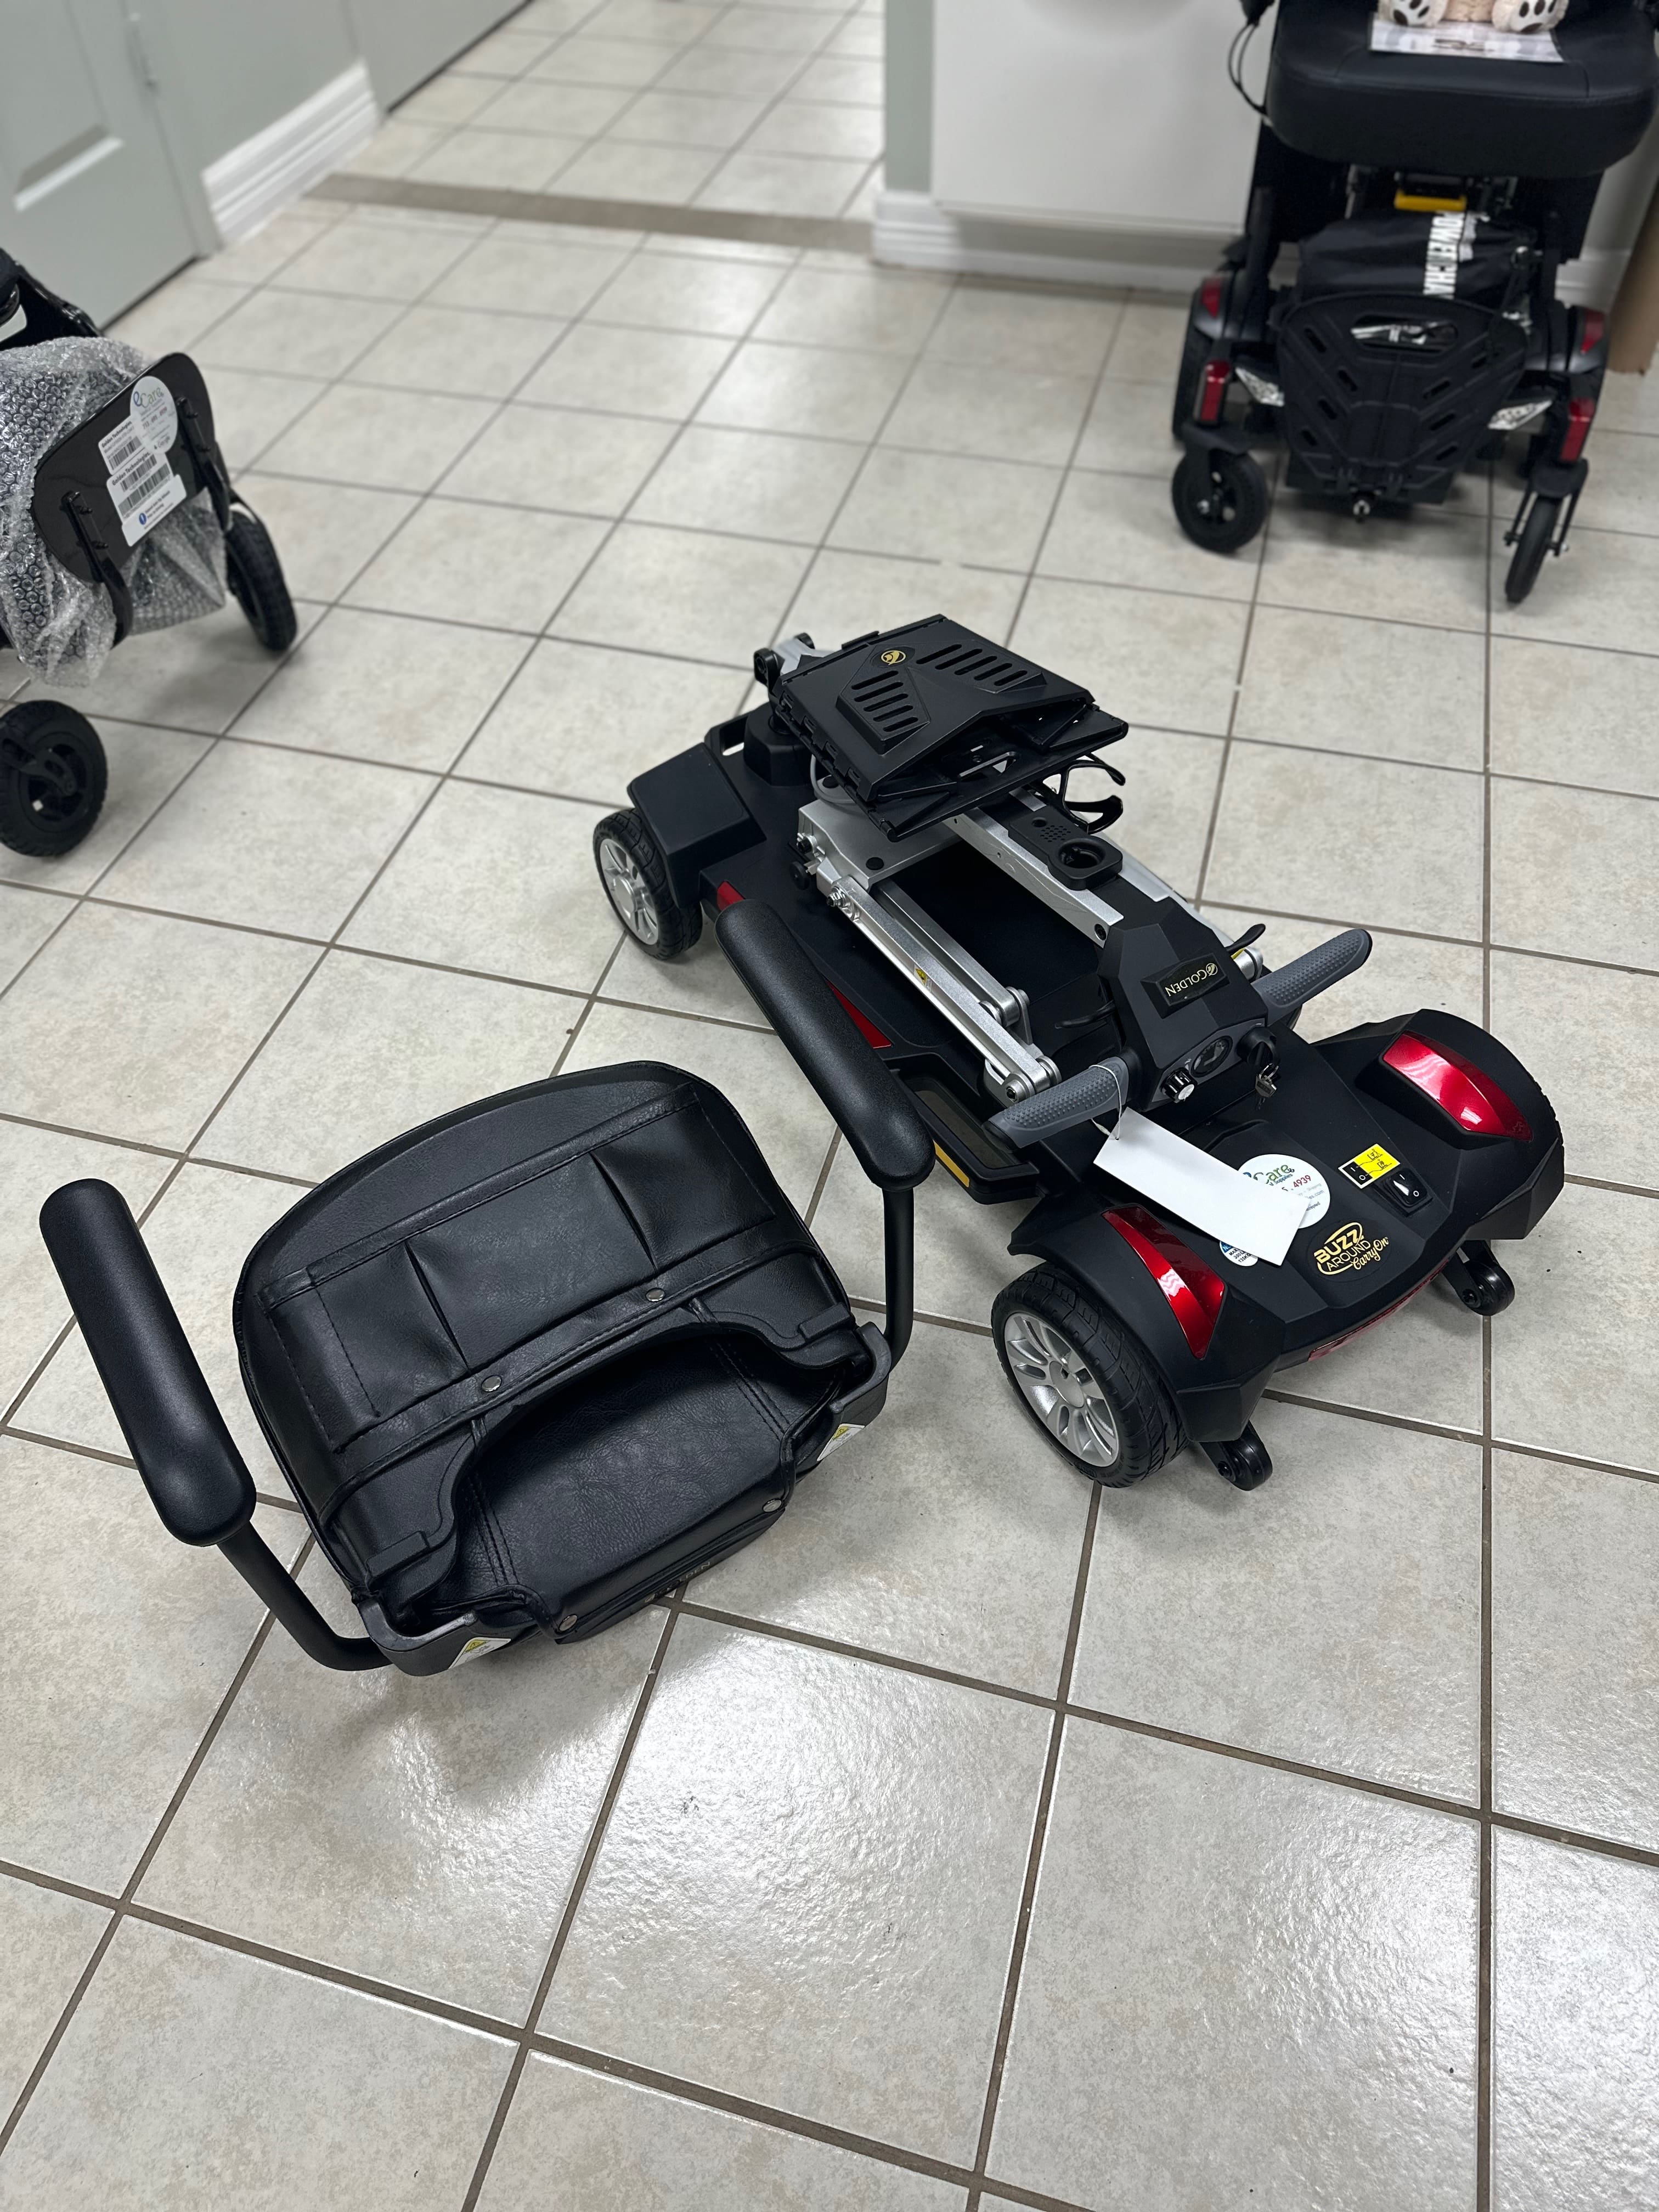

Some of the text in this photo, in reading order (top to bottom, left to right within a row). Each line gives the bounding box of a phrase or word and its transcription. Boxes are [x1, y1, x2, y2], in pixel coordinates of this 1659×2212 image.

[133, 387, 162, 408] eCare
[101, 437, 113, 448] Golden
[112, 472, 127, 486] Golden
[1165, 969, 1207, 997] GOLDEN
[1274, 1173, 1294, 1185] Supplies
[1293, 1174, 1312, 1188] 4939
[1228, 1248, 1238, 1256] MAX
[1313, 1229, 1364, 1264] BUZZ
[1326, 1240, 1371, 1272] AROUND
